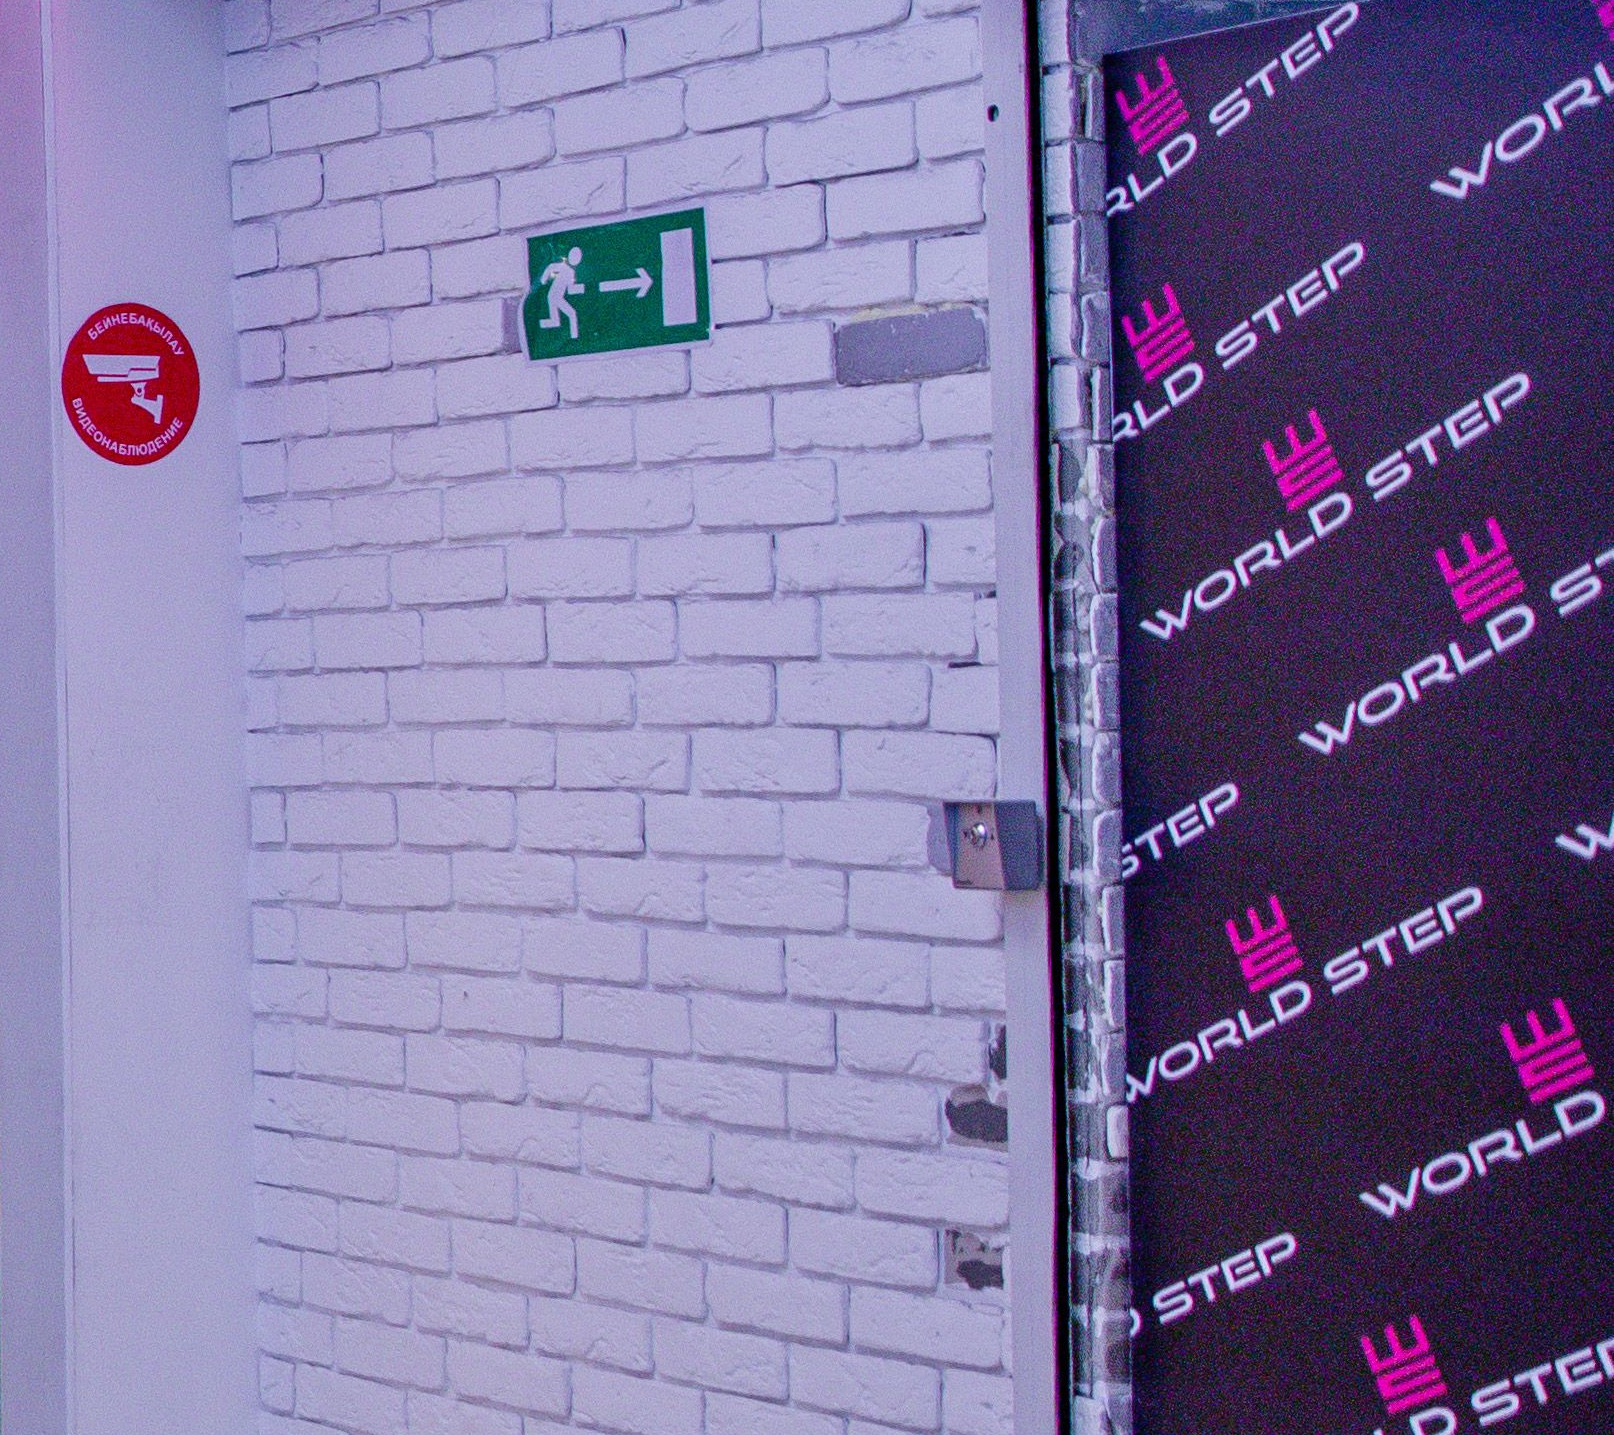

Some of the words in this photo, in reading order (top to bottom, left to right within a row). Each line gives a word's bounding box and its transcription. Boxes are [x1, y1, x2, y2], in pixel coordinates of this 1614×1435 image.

[1207, 0, 1360, 138] STEP
[86, 312, 185, 357] БЕЙНЕБАҚЫЛАУ
[1214, 240, 1365, 370] STEP
[72, 397, 184, 456] ВИДЕОНАБЛЮДЕНИЕ
[1140, 491, 1353, 641] WORLD
[1364, 371, 1531, 502] STEP
[1297, 603, 1536, 755] WORLD
[1322, 885, 1483, 996] STEP
[1359, 1090, 1606, 1218] WORLD
[1153, 1231, 1297, 1324] STEP
